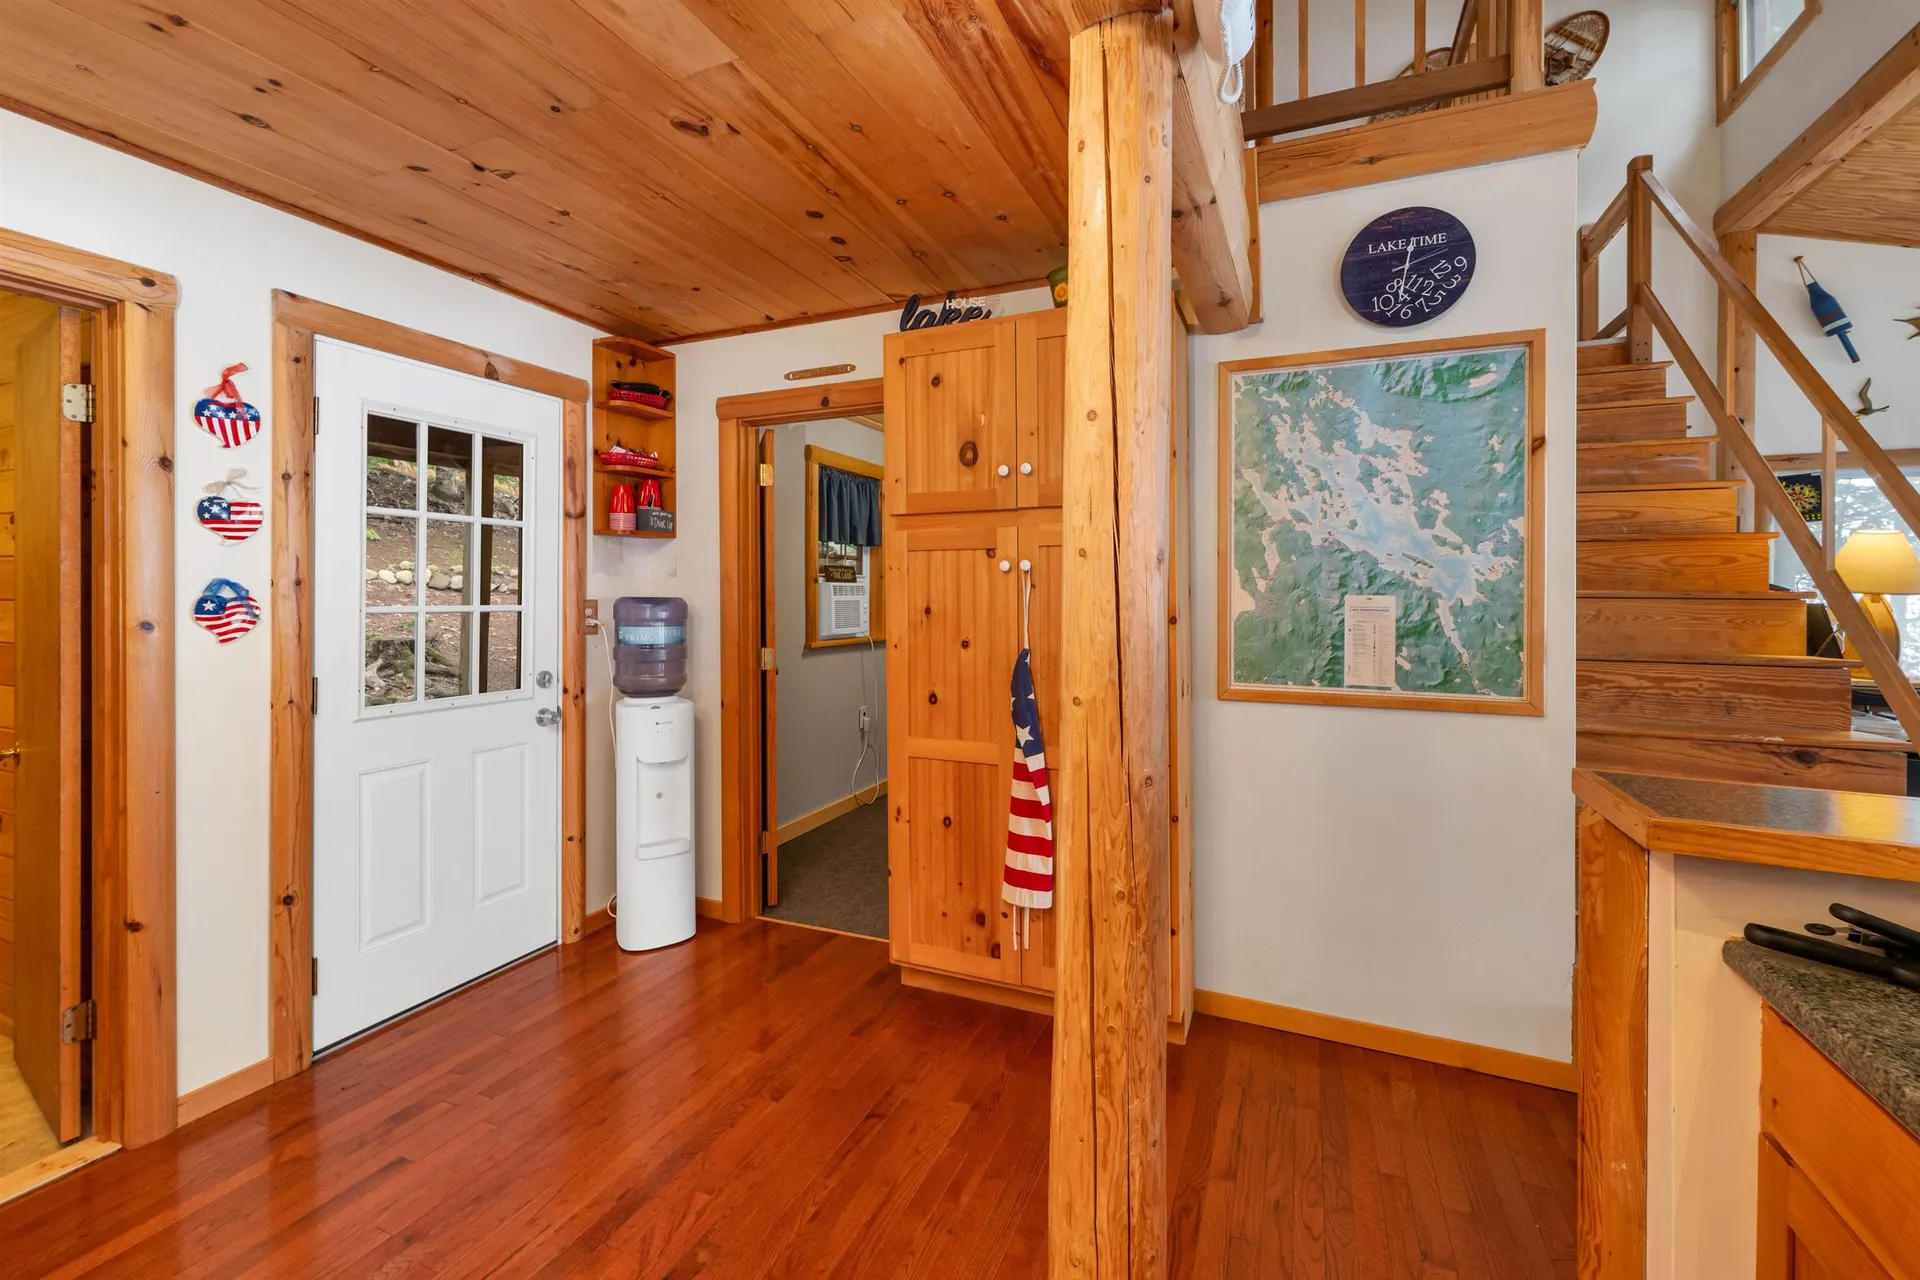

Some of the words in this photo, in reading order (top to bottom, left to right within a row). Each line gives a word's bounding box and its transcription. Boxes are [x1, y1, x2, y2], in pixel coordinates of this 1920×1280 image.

[1368, 238, 1407, 254] LAKE
[1411, 232, 1448, 248] TIME
[1429, 259, 1452, 280] 12
[1386, 278, 1402, 293] 8
[1404, 274, 1424, 293] 11
[1421, 279, 1435, 296] 2
[1442, 274, 1462, 289] 3
[945, 296, 987, 310] HOUSE
[1371, 294, 1395, 312] 10
[1398, 288, 1411, 302] 4
[1428, 290, 1447, 306] 5
[899, 289, 992, 332] lake
[1386, 303, 1402, 318] 1
[1400, 303, 1414, 319] 6
[1414, 297, 1432, 313] 7
[625, 633, 656, 641] PRIMO
